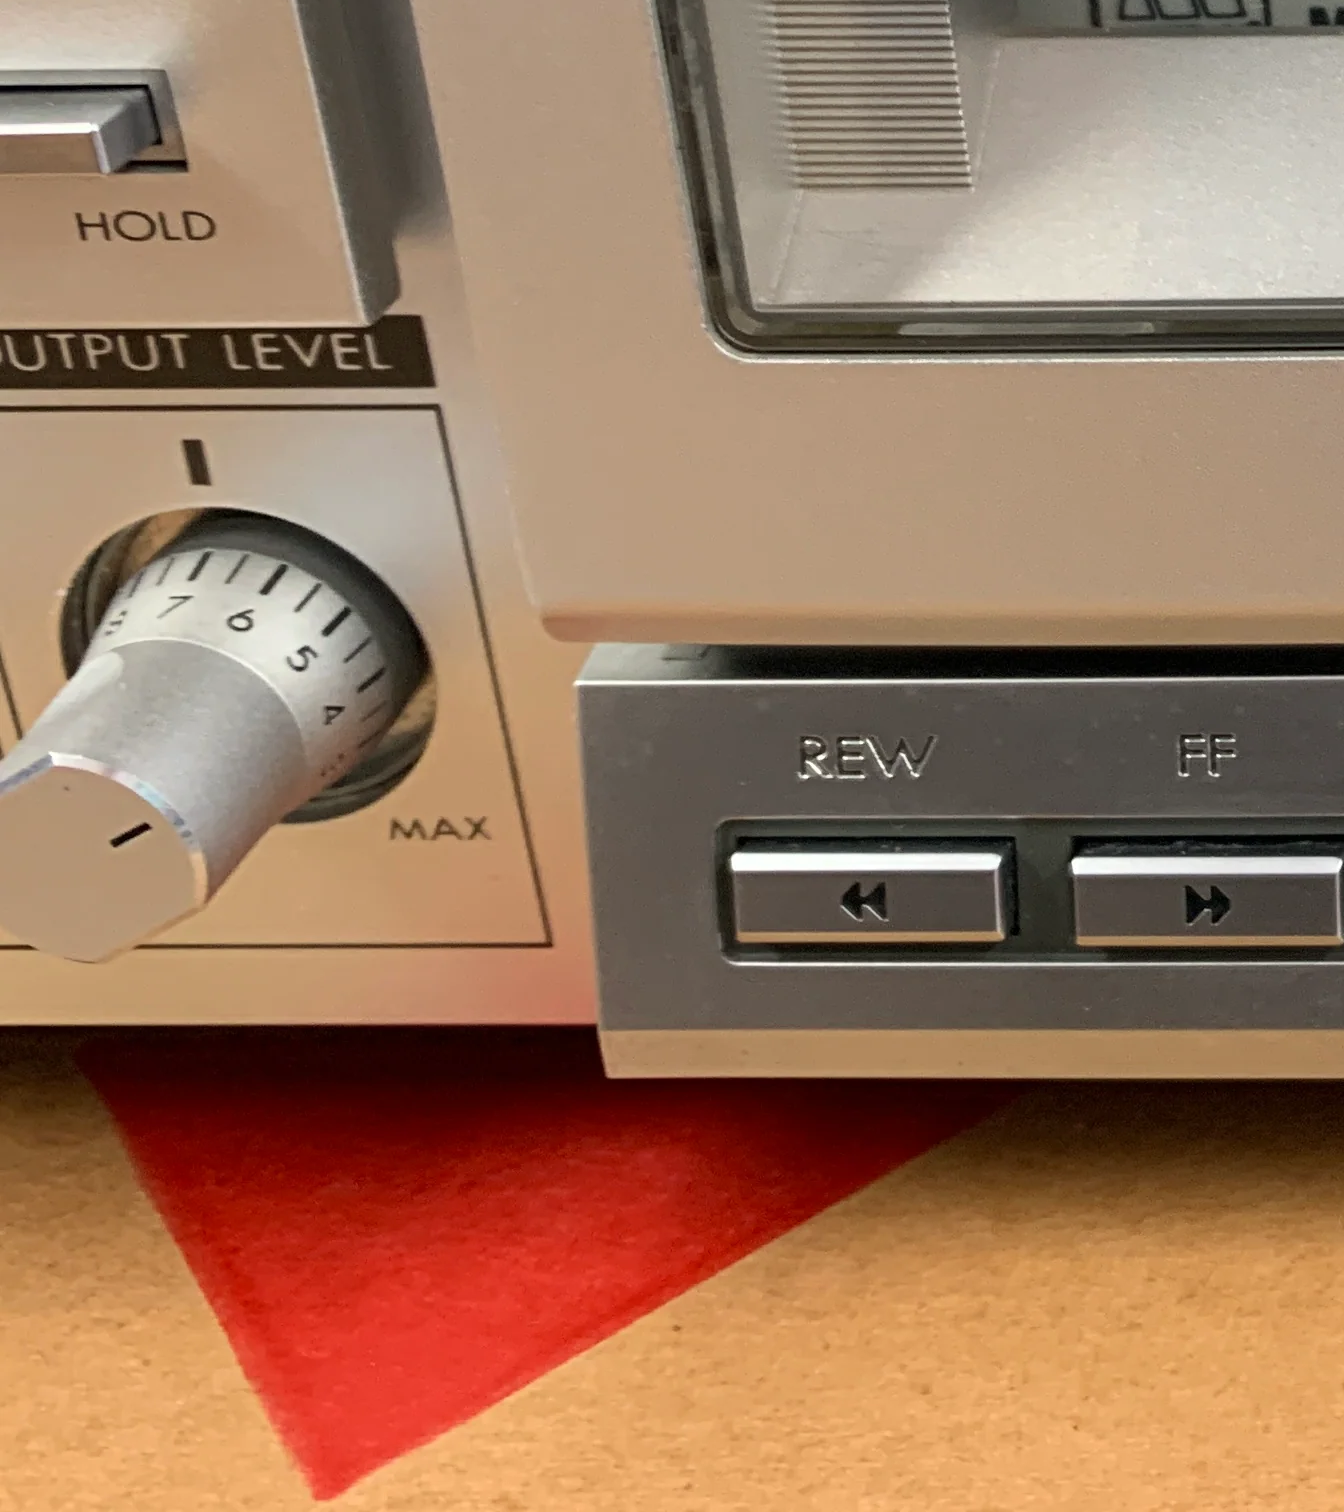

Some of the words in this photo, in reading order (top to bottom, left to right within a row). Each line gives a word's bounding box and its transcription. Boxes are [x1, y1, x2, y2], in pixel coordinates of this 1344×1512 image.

[75, 210, 217, 242] HOLD
[0, 333, 190, 372] UTPUT
[221, 333, 393, 371] LEVEL
[226, 609, 254, 632] 6
[286, 646, 318, 672] 5
[323, 704, 345, 726] 4
[796, 734, 937, 780] REW
[1176, 732, 1238, 778] FF
[389, 816, 492, 841] MAX
